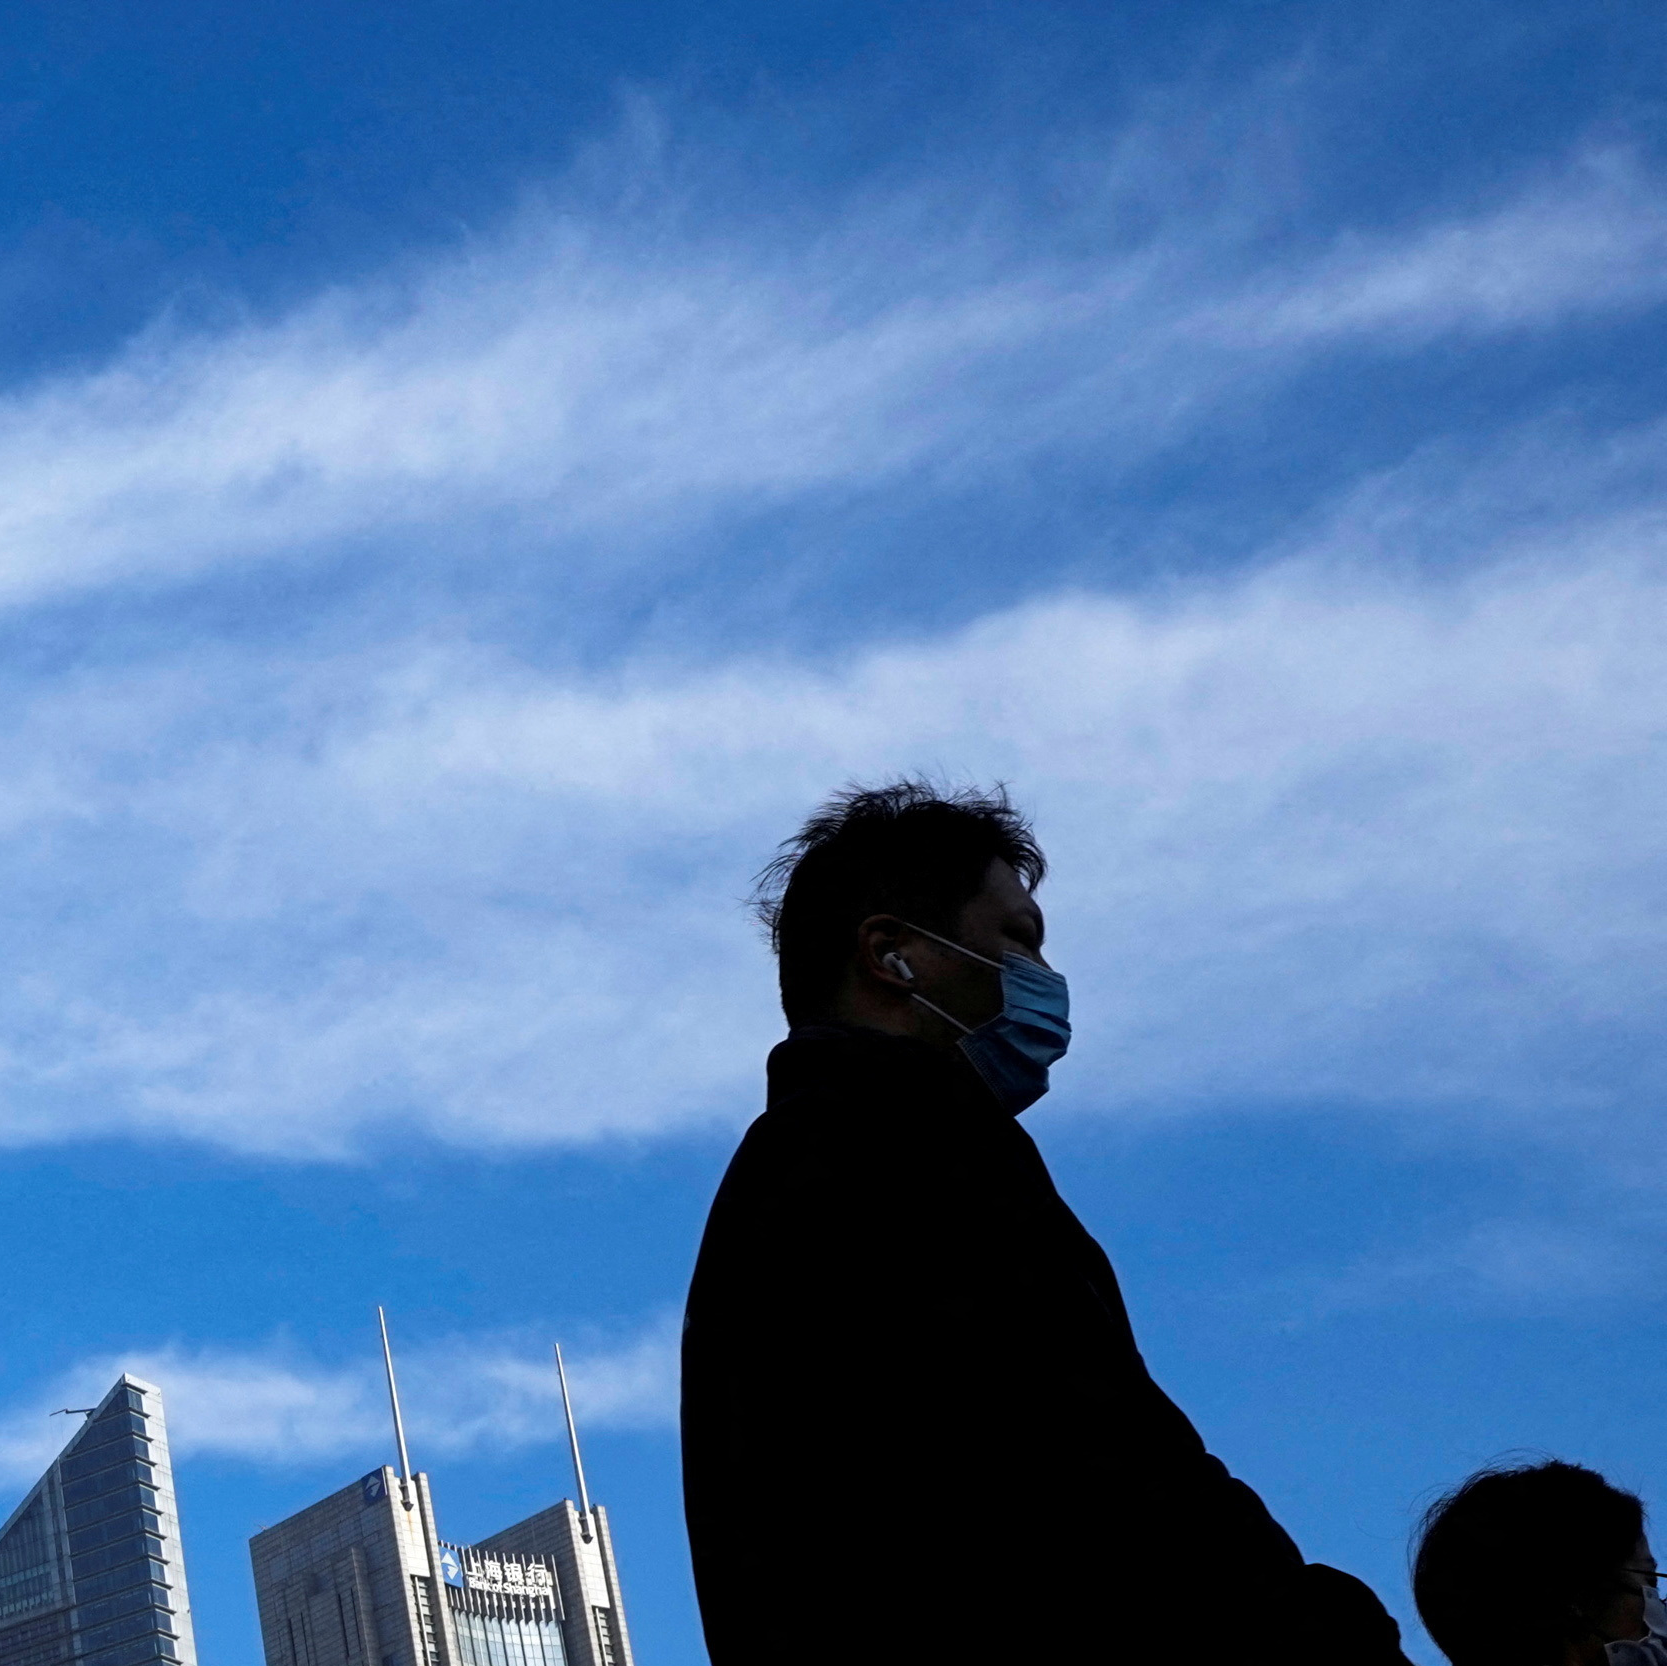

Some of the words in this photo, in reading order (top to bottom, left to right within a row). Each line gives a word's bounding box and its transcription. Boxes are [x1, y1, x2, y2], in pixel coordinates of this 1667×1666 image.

[466, 1557, 551, 1584] 上海银行
[468, 1577, 491, 1591] Bank
[492, 1582, 503, 1593] of
[503, 1582, 553, 1597] Shanghai
